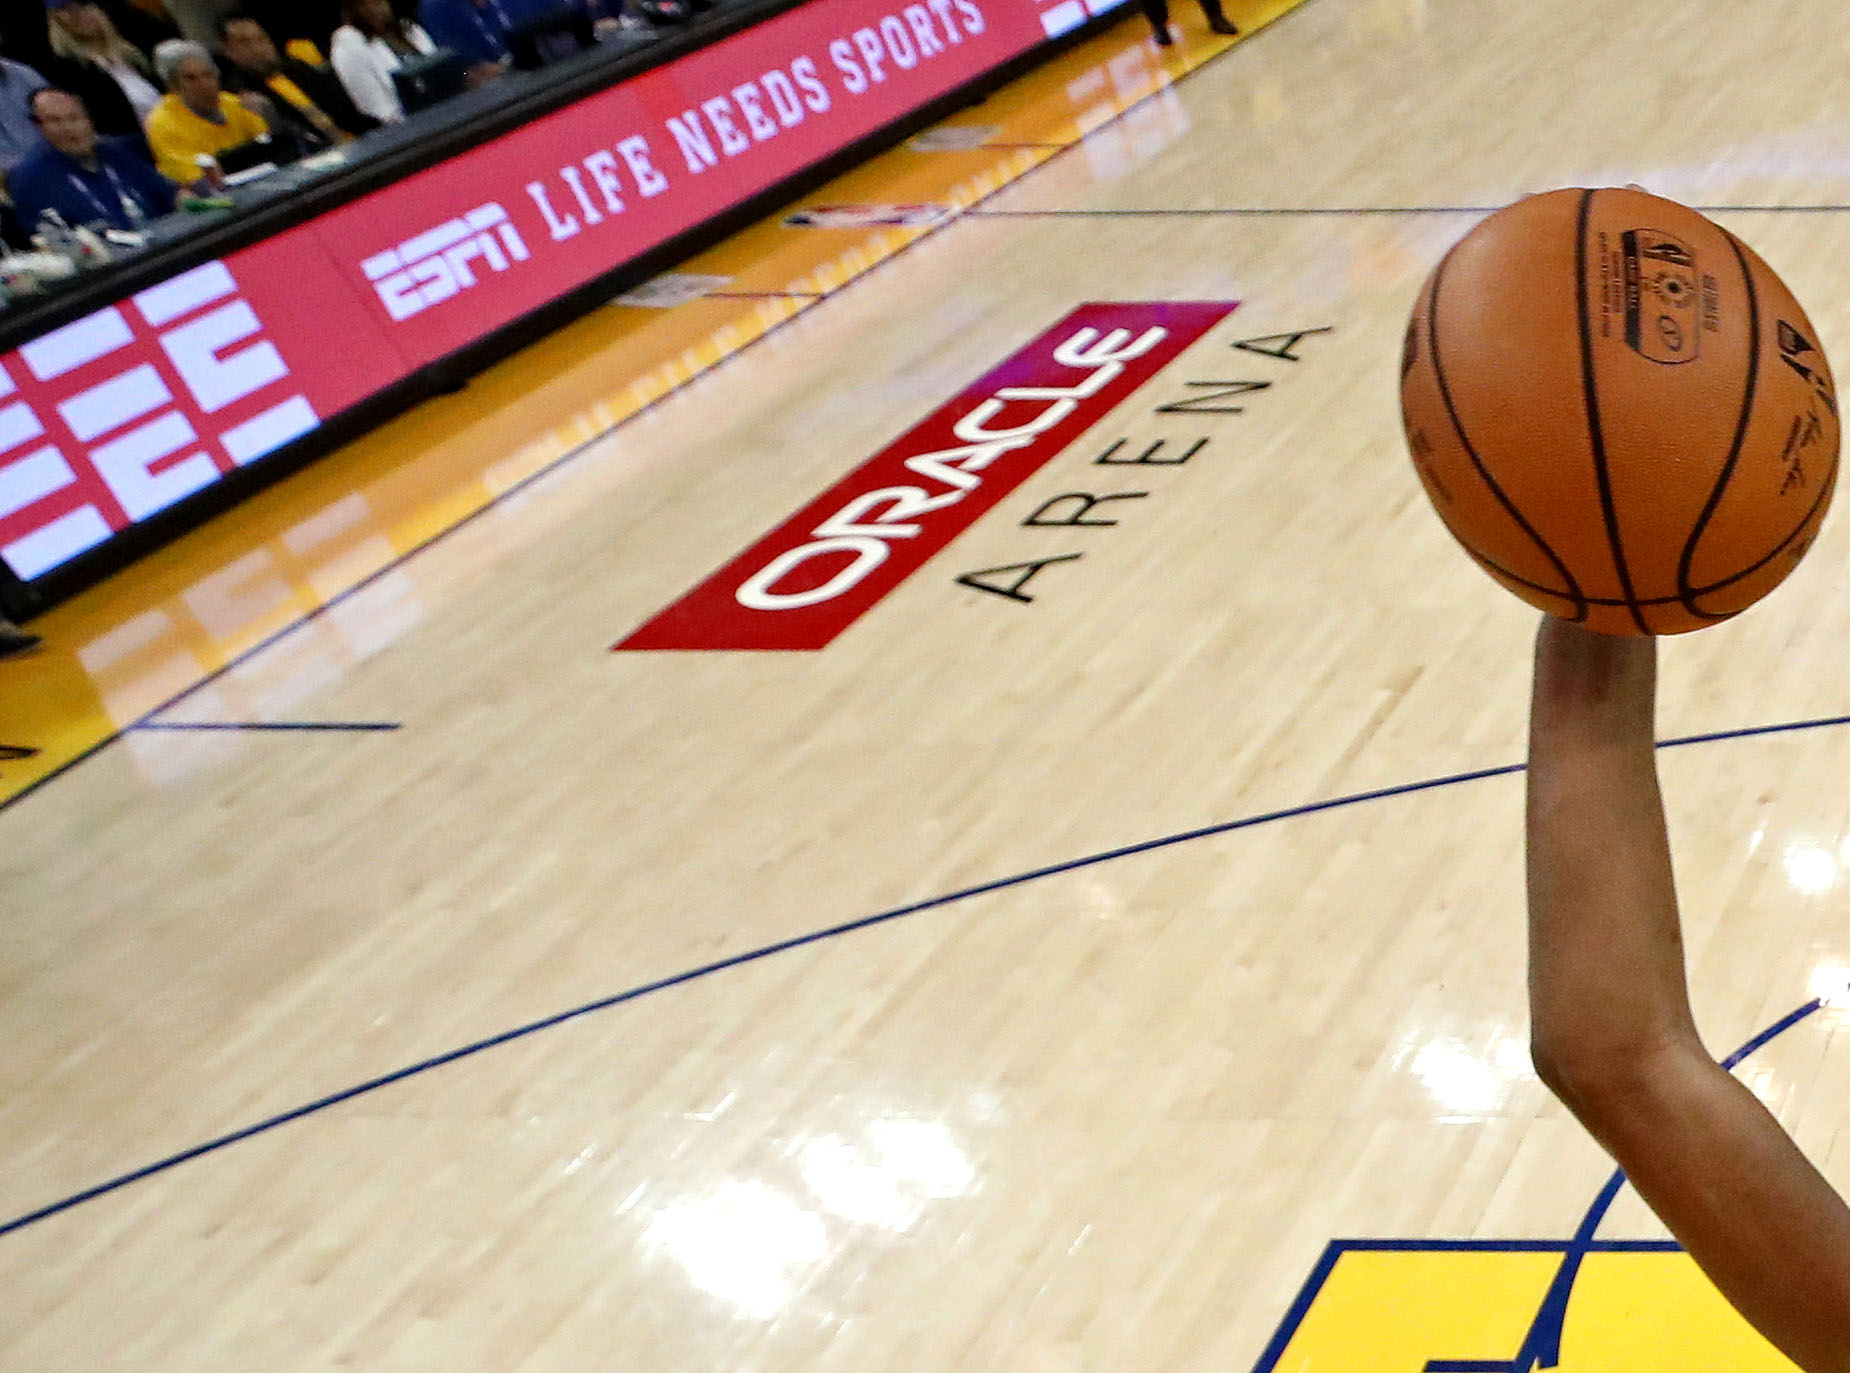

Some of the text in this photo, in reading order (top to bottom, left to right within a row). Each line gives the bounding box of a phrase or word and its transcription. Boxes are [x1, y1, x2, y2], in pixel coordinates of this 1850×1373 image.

[359, 201, 531, 322] ESPN
[525, 135, 669, 242] LIFE
[665, 54, 831, 175] NEEDS
[734, 326, 1167, 611] ORACLE
[954, 326, 1333, 604] ARENA
